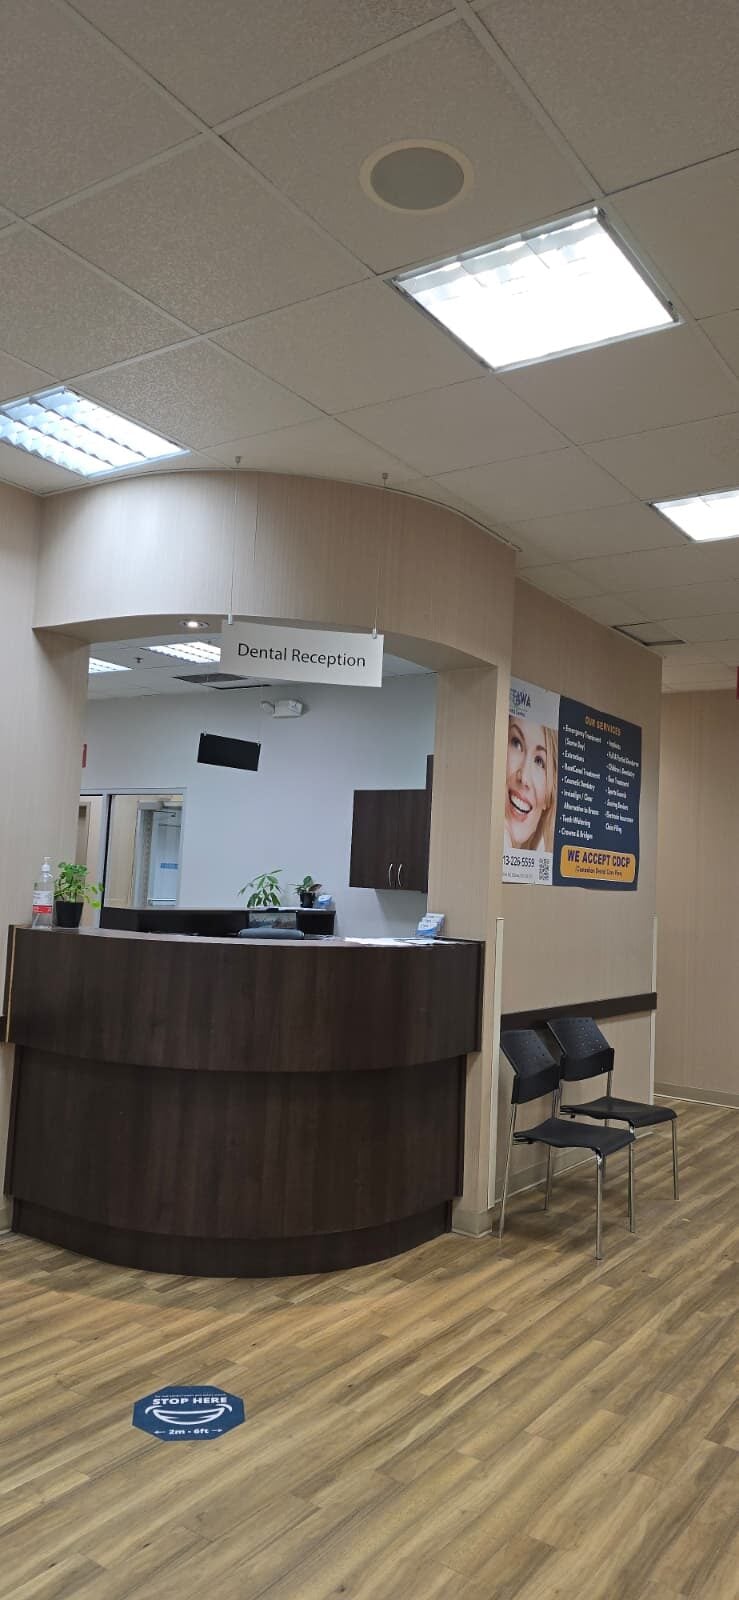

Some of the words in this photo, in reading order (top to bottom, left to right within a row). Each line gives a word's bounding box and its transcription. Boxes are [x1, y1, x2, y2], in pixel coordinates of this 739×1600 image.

[238, 642, 287, 661] Dental
[292, 648, 366, 668] Reception
[585, 715, 596, 727] OUR
[596, 720, 623, 736] SERVICES
[568, 849, 580, 862] WE
[582, 852, 611, 866] ACCEPT
[612, 855, 631, 868] CDCP
